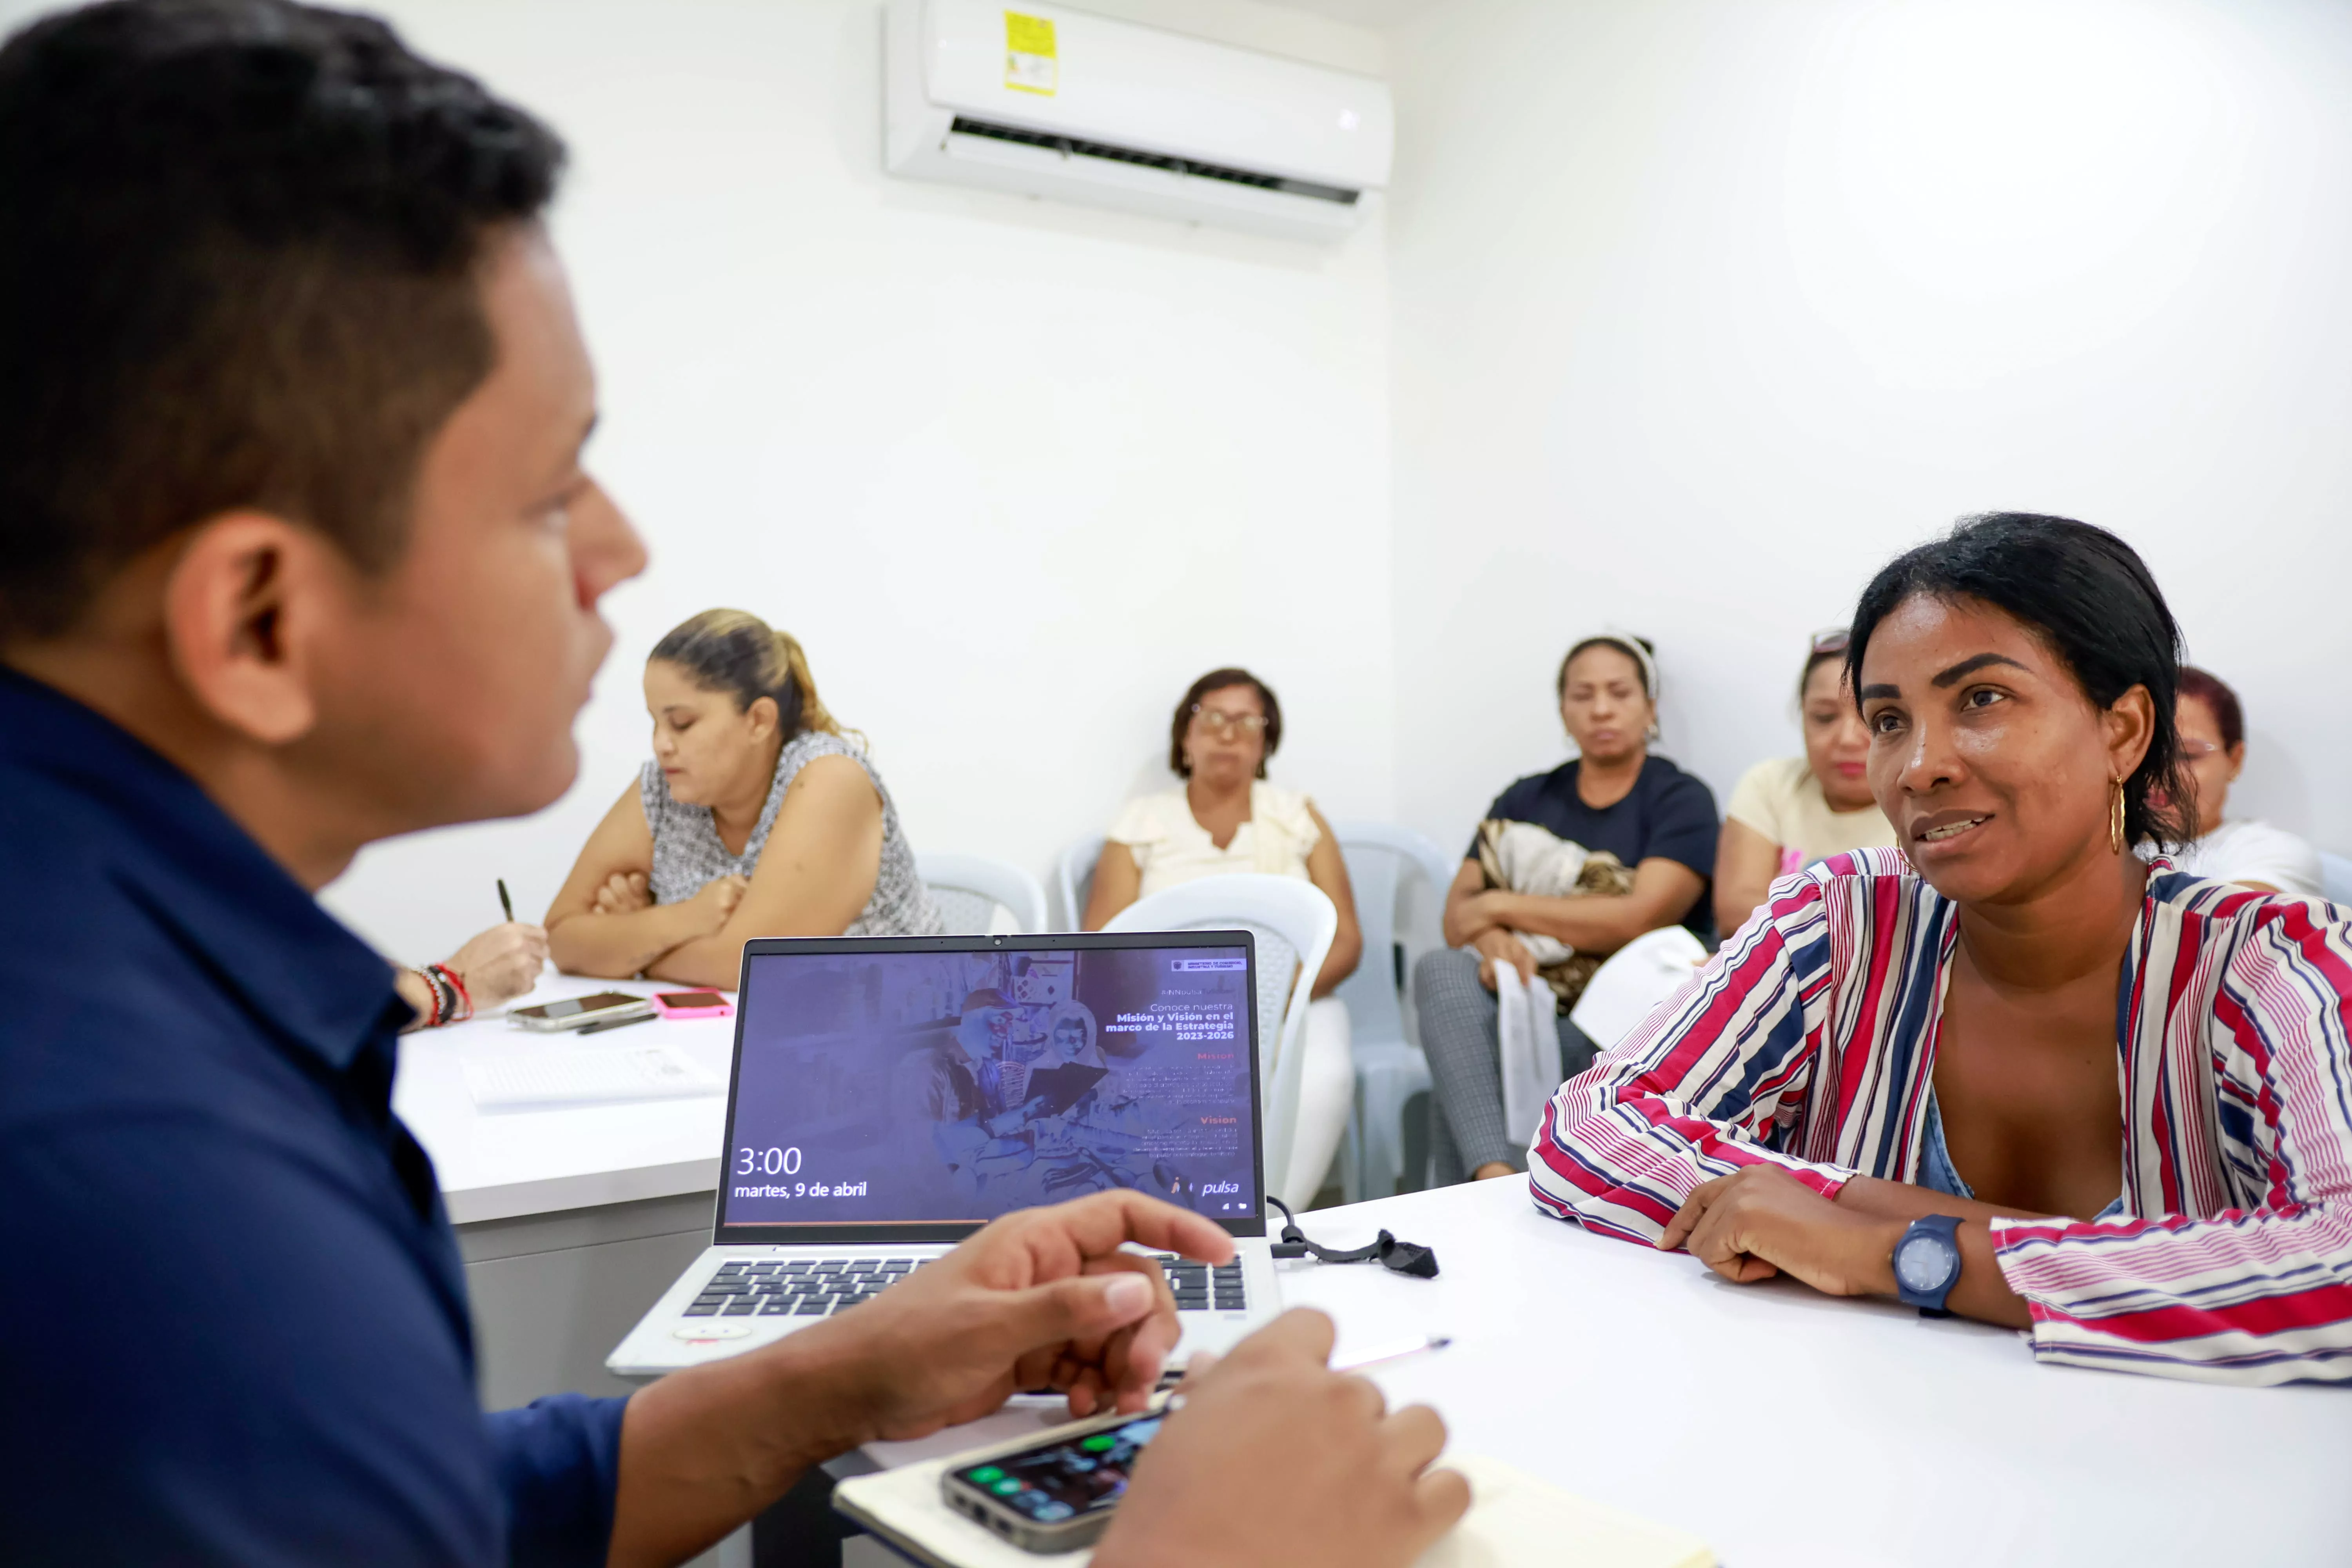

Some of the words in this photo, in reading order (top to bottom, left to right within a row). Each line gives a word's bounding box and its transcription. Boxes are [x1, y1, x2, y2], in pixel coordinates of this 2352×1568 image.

[1117, 1013, 1154, 1022] Misión
[1167, 1012, 1203, 1021] Visión
[1145, 1023, 1160, 1032] de
[1163, 1022, 1172, 1031] la
[1176, 1021, 1234, 1031] Estrategia
[1177, 1031, 1234, 1040] 2023-2026
[737, 1147, 802, 1175] 3:00
[734, 1184, 790, 1199] martes,
[795, 1182, 806, 1197] 9
[809, 1182, 829, 1196] de
[833, 1181, 867, 1196] abril
